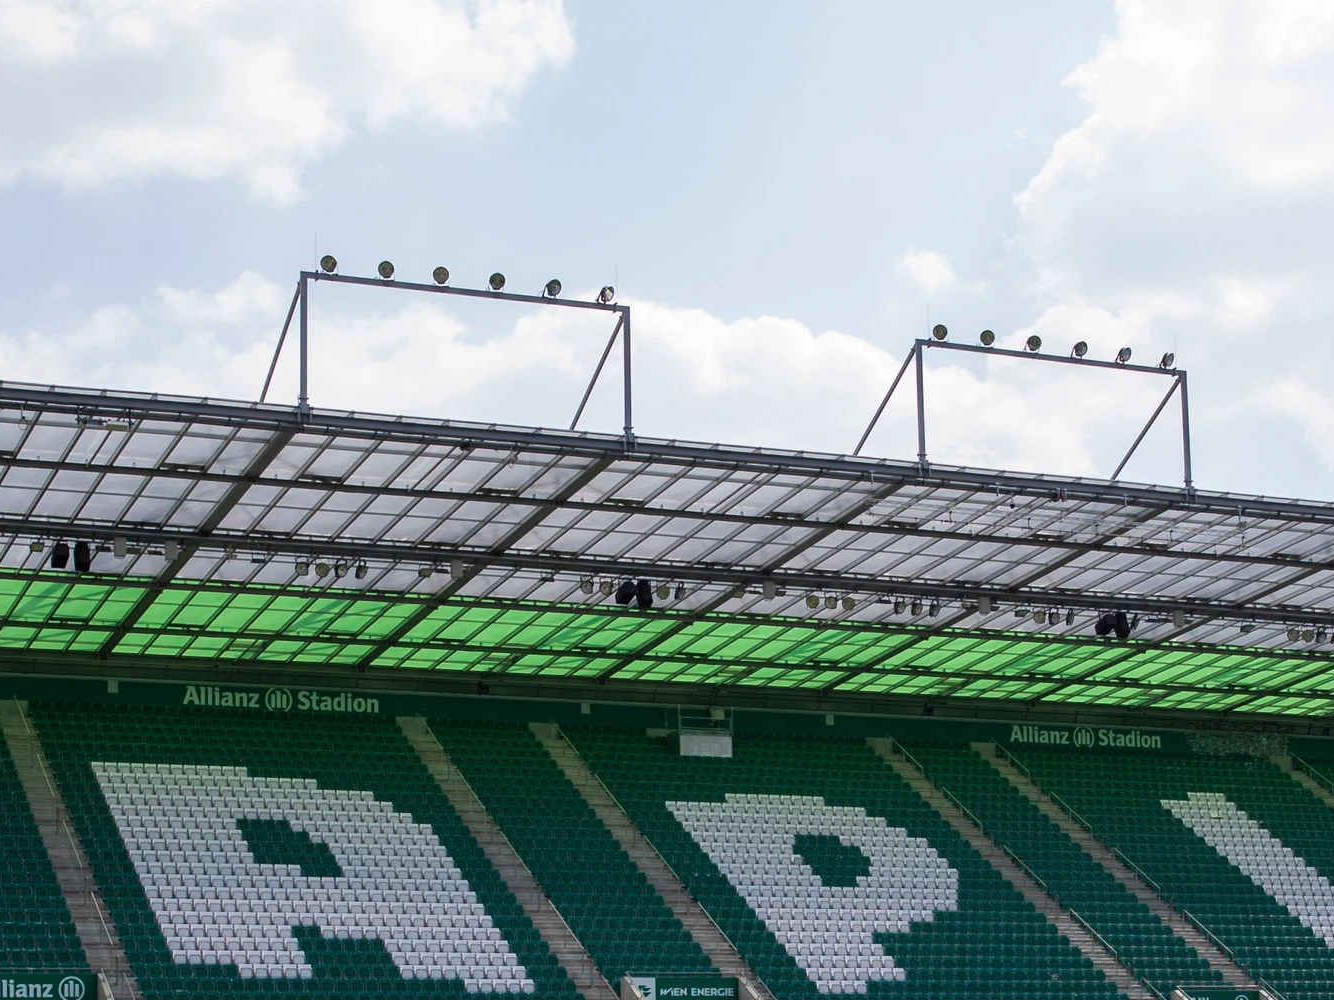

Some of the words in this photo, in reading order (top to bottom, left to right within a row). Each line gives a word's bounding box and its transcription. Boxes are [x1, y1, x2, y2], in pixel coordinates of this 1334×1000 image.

[182, 685, 260, 708] Allianz
[297, 690, 380, 713] Stadion
[1009, 725, 1070, 745] Allianz
[1098, 729, 1162, 749] Stadion
[659, 987, 688, 997] WIEN
[690, 987, 735, 997] ENERGIE
